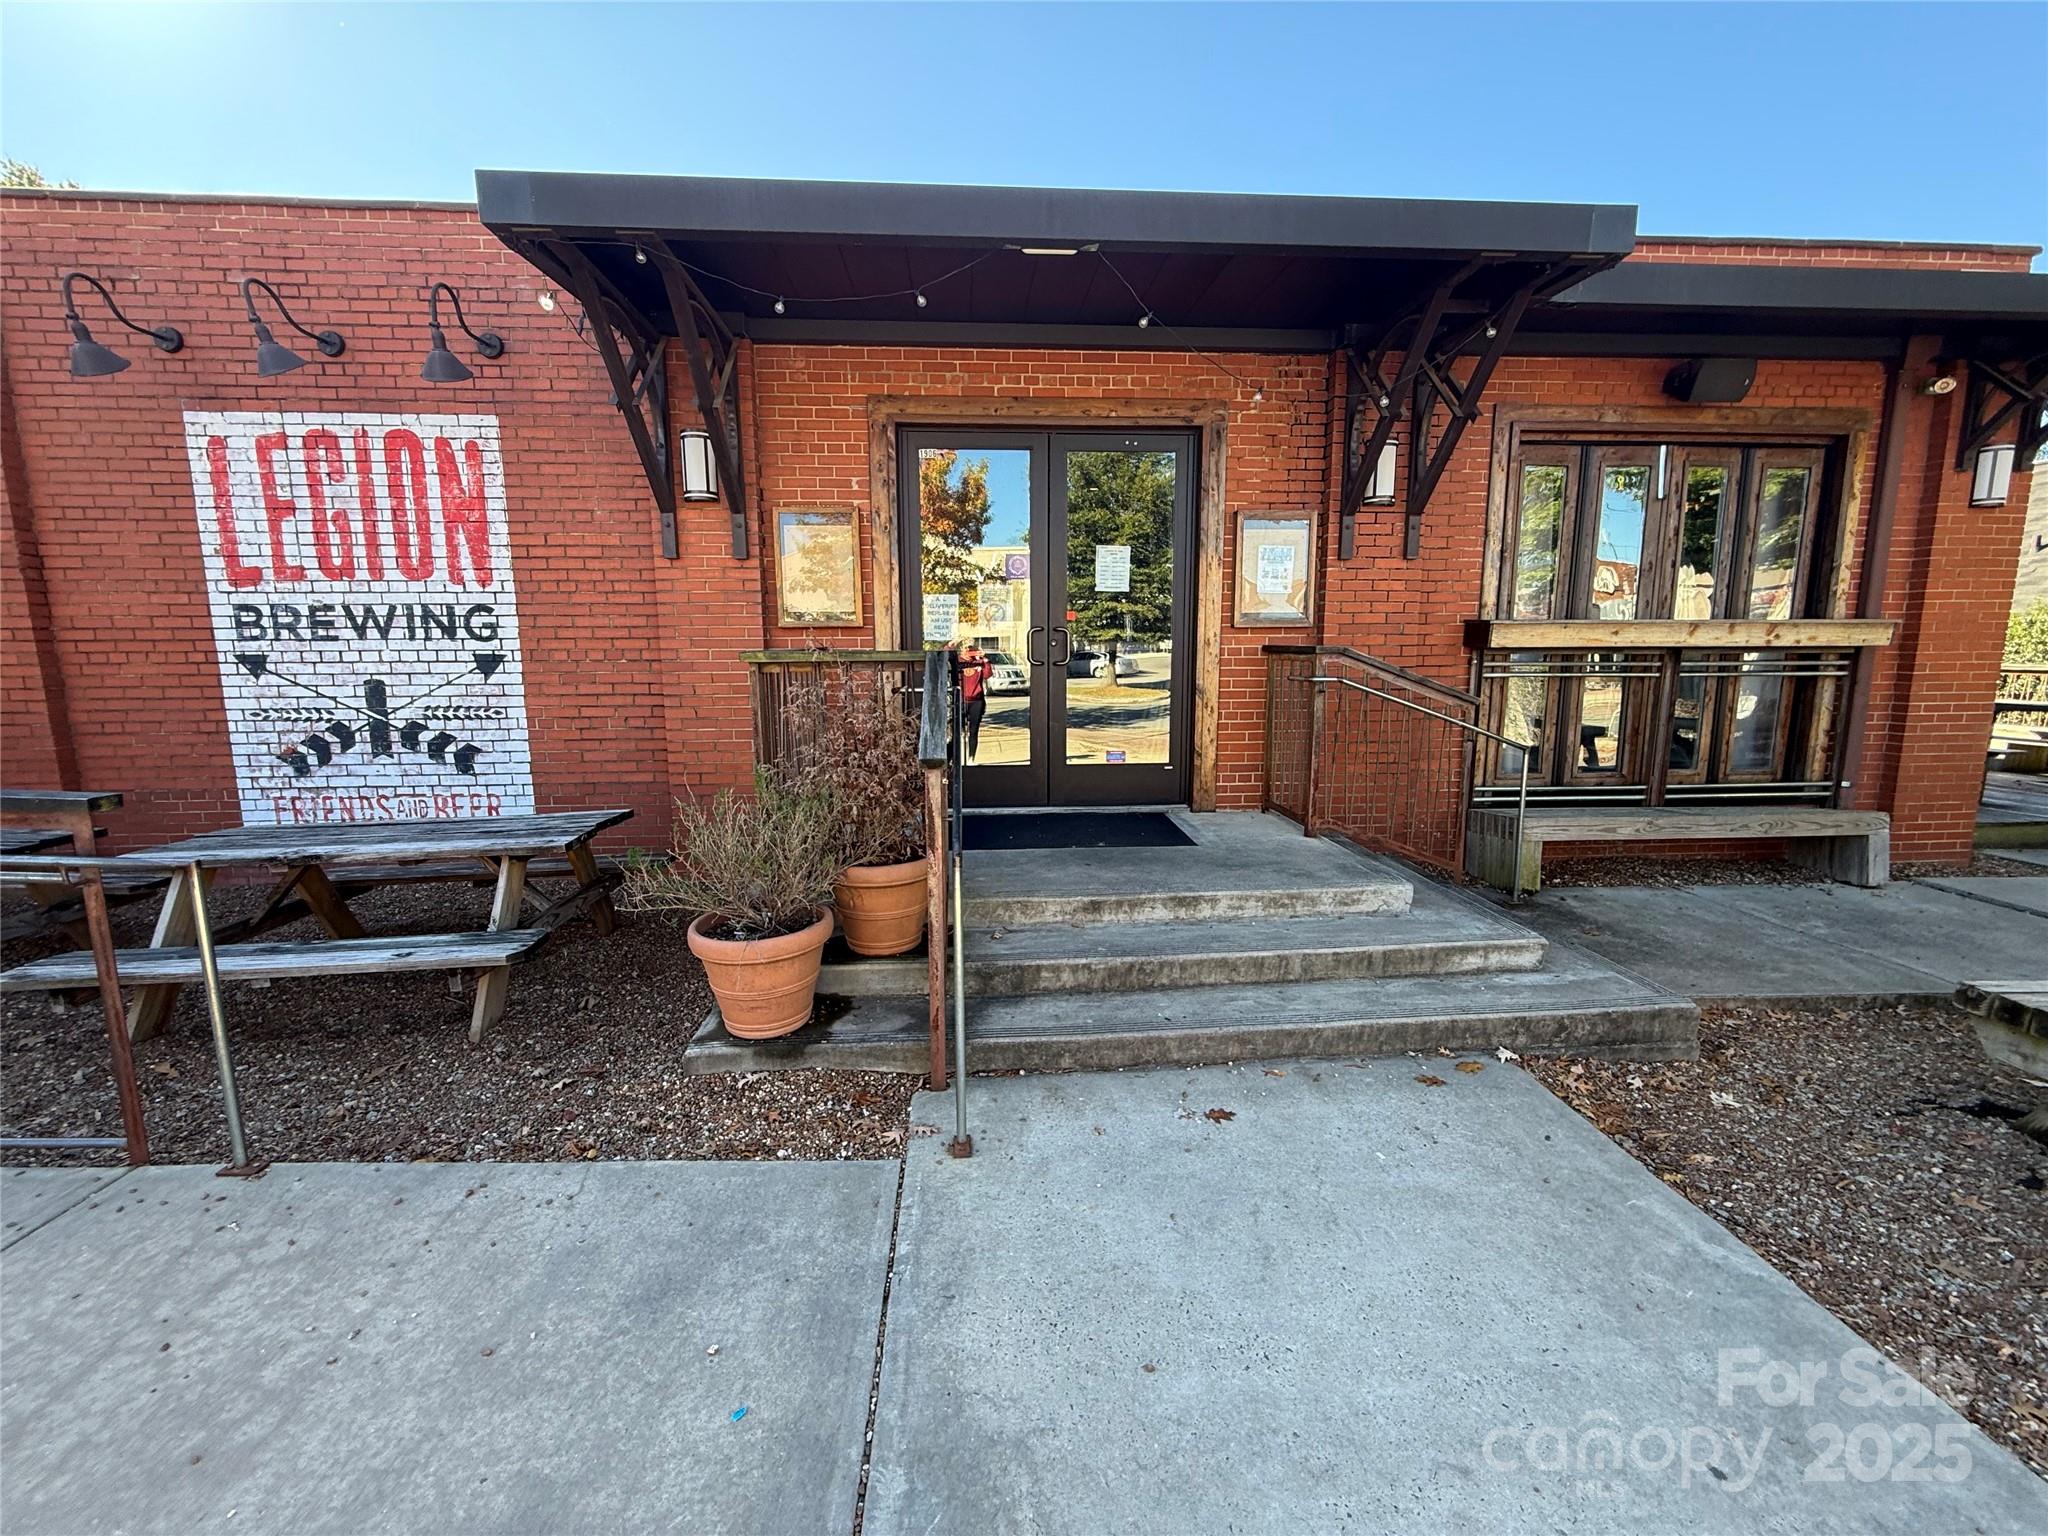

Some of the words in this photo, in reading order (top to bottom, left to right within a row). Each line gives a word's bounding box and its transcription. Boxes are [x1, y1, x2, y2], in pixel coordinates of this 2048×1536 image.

[206, 428, 493, 588] LEGION
[233, 605, 499, 642] BREWING
[273, 794, 396, 824] FRIENDS
[396, 799, 428, 818] AND
[432, 793, 501, 819] BEER
